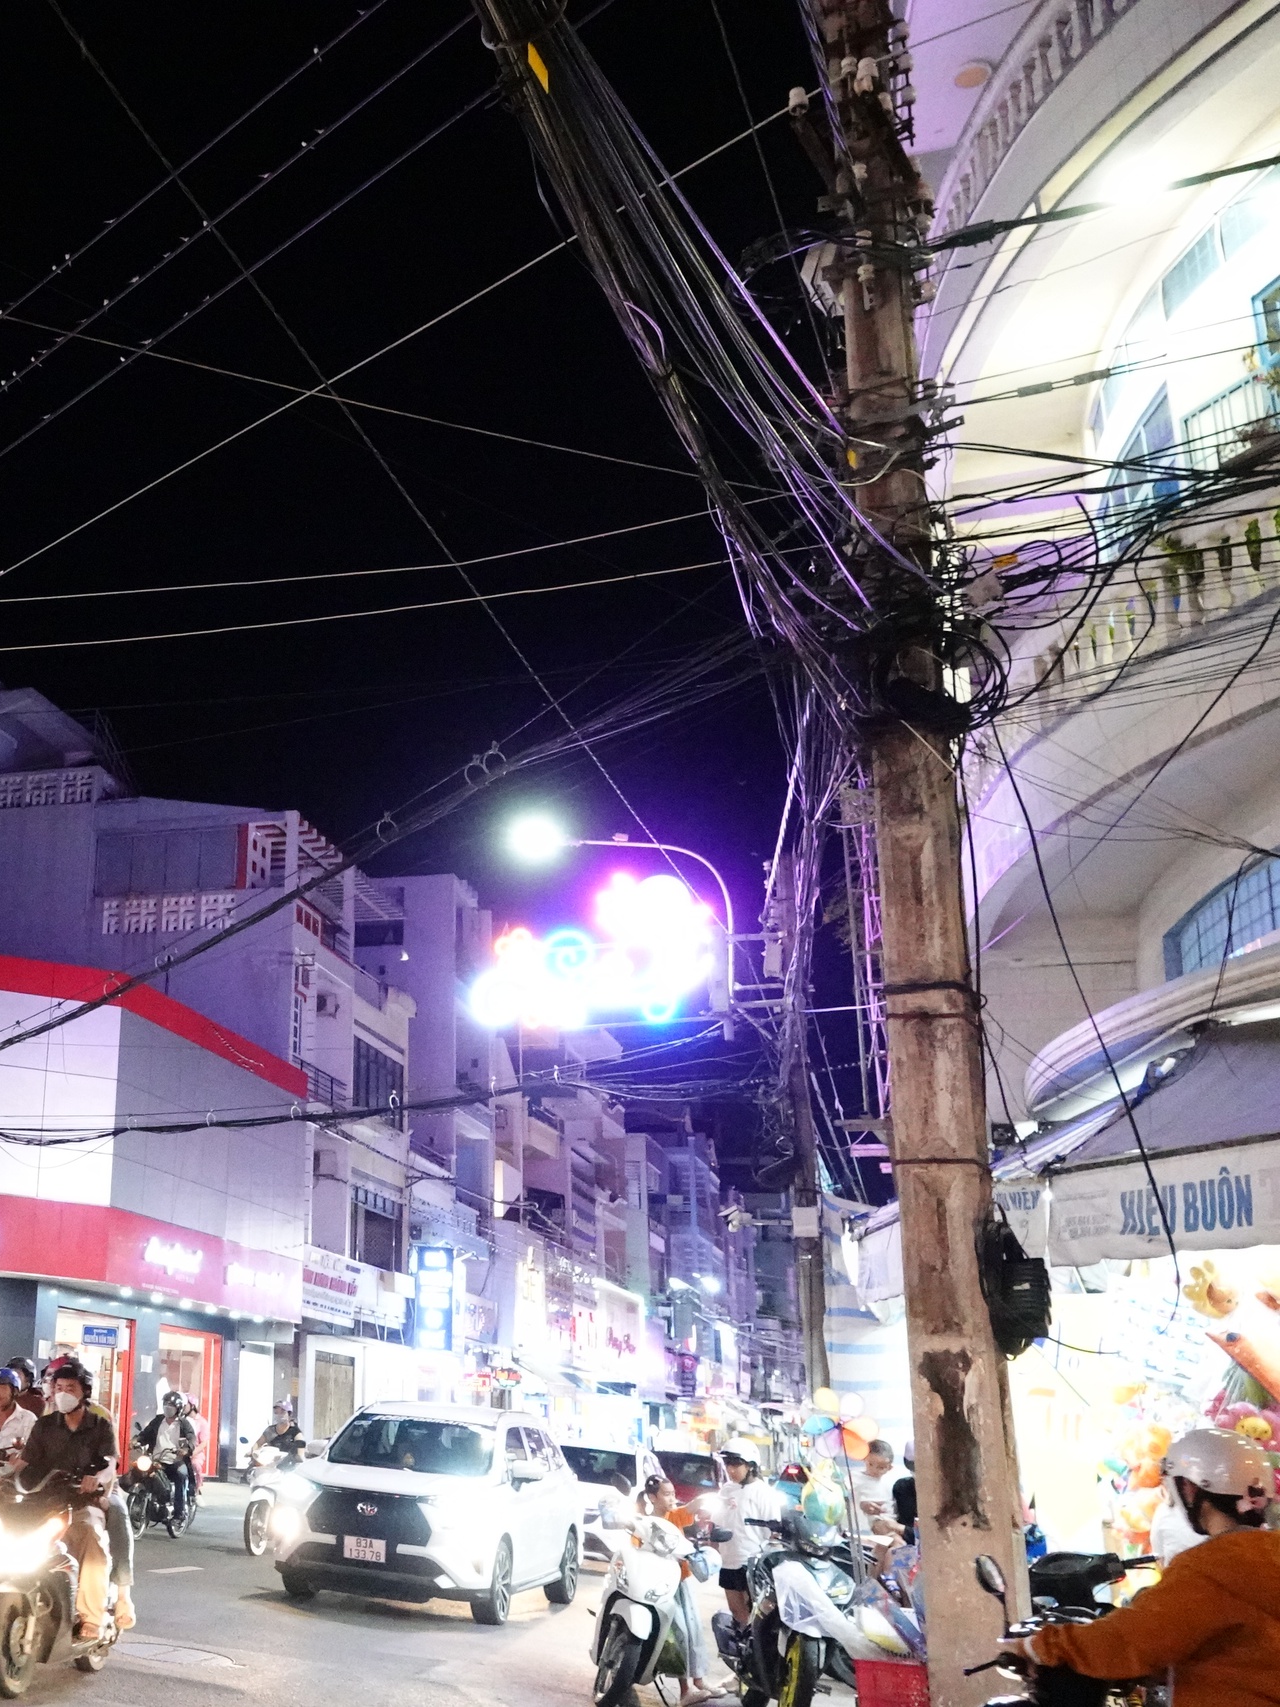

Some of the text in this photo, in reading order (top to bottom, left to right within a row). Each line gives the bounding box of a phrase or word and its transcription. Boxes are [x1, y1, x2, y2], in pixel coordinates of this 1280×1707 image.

[1182, 1166, 1253, 1233] BUÔN
[355, 1537, 374, 1549] 83A
[349, 1547, 382, 1561] 133.78
